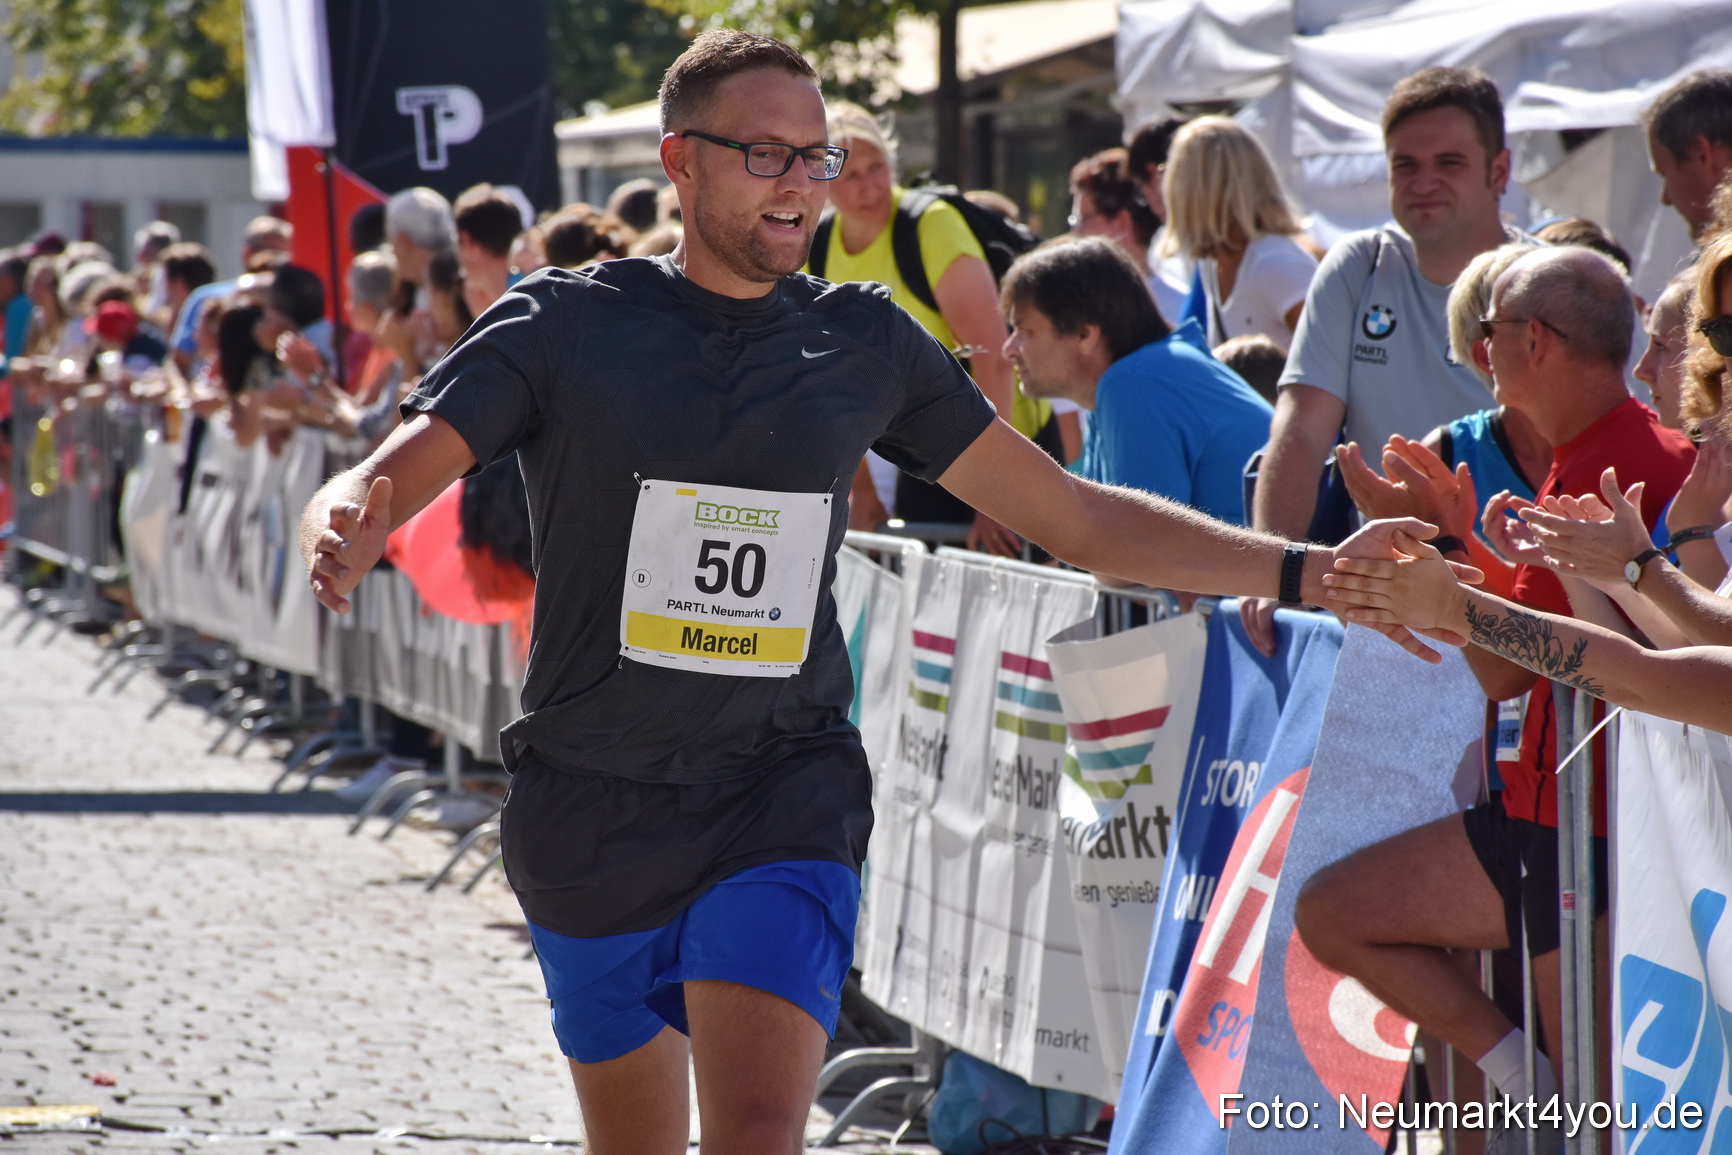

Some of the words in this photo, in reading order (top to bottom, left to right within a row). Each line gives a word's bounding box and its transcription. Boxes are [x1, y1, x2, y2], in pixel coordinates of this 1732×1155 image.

[1355, 344, 1389, 360] PARTL
[695, 501, 781, 528] BOCK
[693, 521, 721, 531] inspired
[721, 524, 730, 532] by
[751, 529, 779, 537] concepts
[637, 573, 646, 584] D
[694, 539, 767, 599] 50
[667, 599, 709, 615] PARTL
[711, 605, 765, 619] Neumarkt
[680, 626, 758, 656] Marcel
